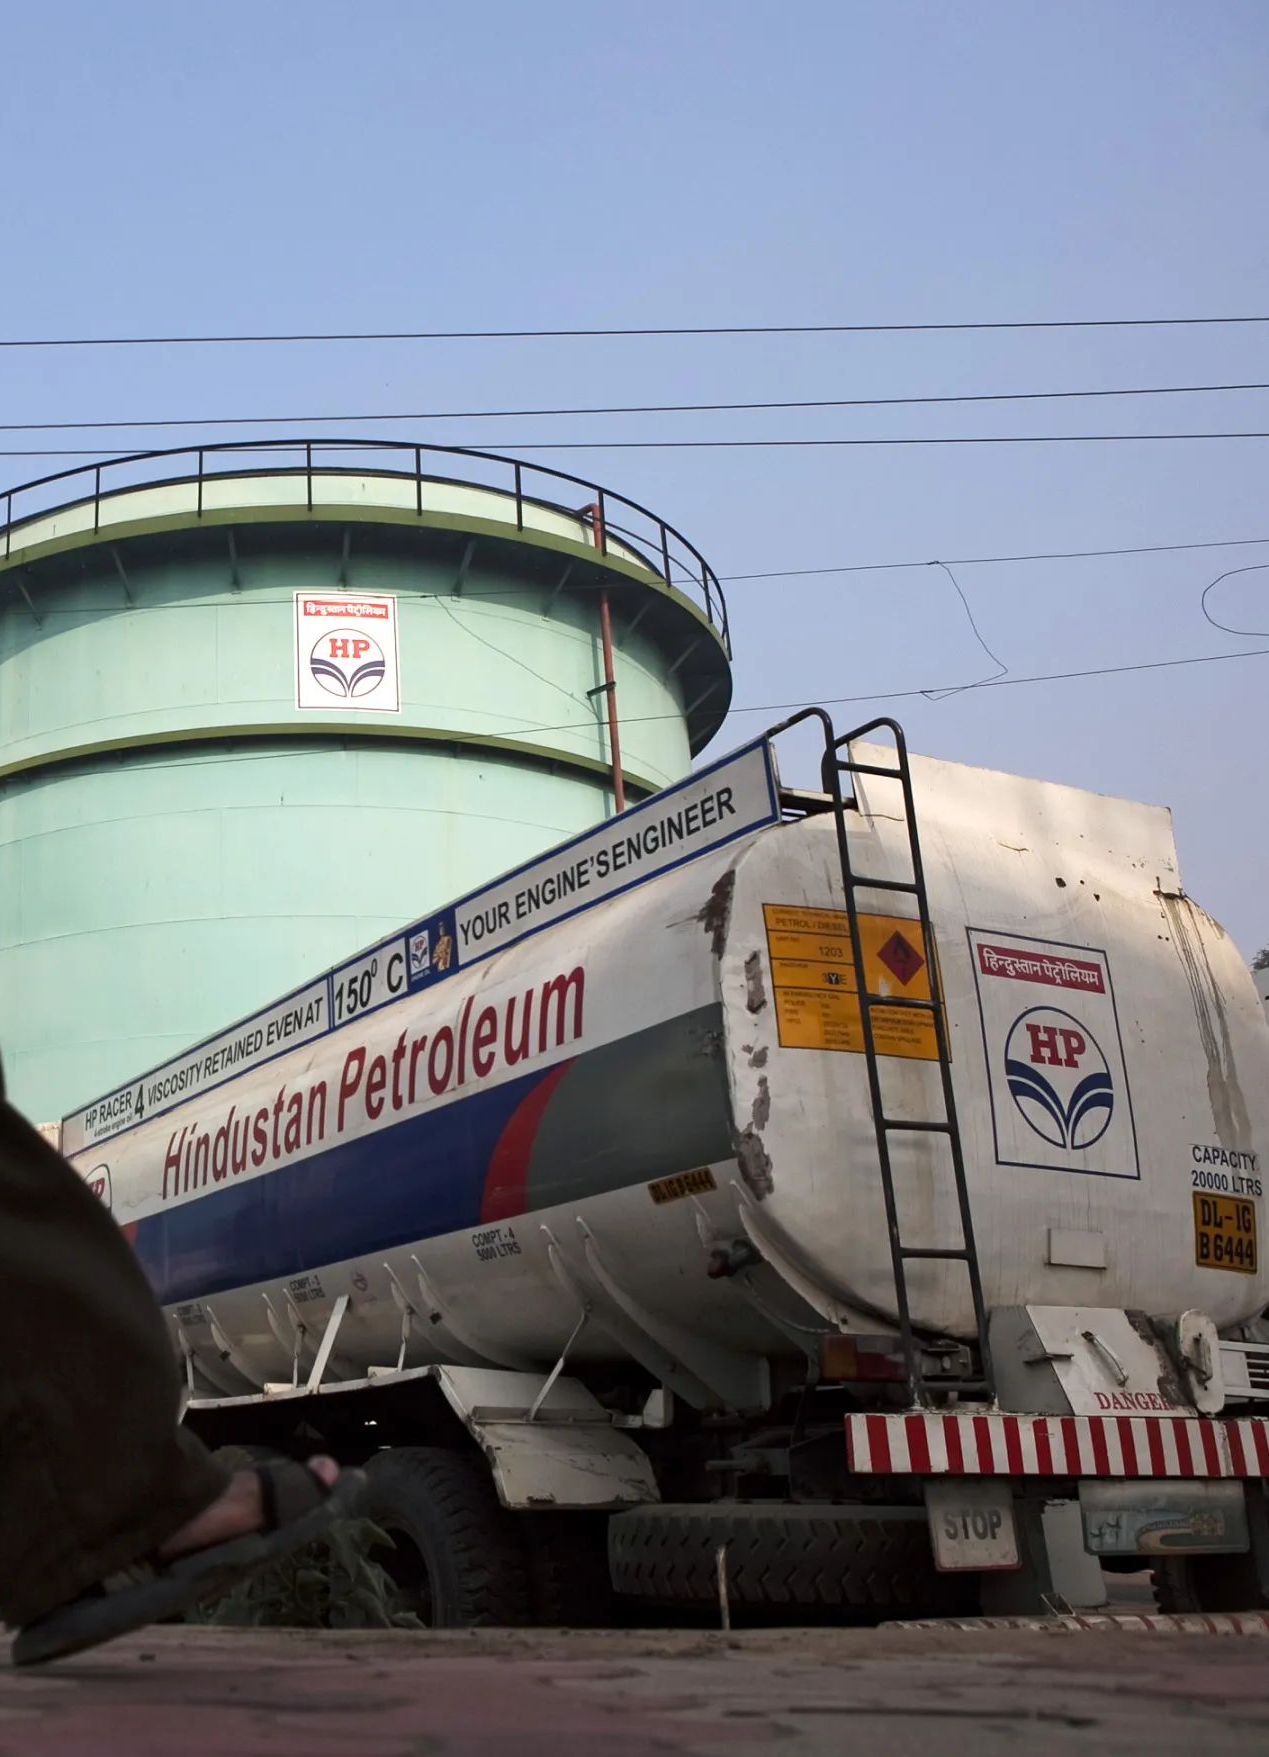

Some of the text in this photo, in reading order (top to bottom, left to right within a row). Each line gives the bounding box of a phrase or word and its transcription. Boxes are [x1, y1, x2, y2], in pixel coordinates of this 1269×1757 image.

[329, 639, 370, 658] HP
[460, 901, 511, 946] YOUR
[775, 918, 811, 929] PETROL
[819, 946, 843, 958] 1203
[982, 947, 1099, 986] हिन्दुस्तान पेट्रोलियम
[387, 952, 404, 993] C
[1025, 1023, 1086, 1068] HP
[85, 1109, 97, 1131] HP
[99, 1090, 132, 1124] RACER
[134, 1084, 145, 1120] 4
[147, 1062, 204, 1107] VISCOSITY
[203, 1029, 263, 1080] RETAINED
[162, 965, 585, 1200] Hindustan Petroleum
[1192, 1145, 1256, 1171] CAPACITY
[1191, 1170, 1263, 1196] 20000 LTRS
[471, 1228, 502, 1248] COMPT
[496, 1241, 522, 1257] LTRS
[943, 1508, 1002, 1540] STOP
